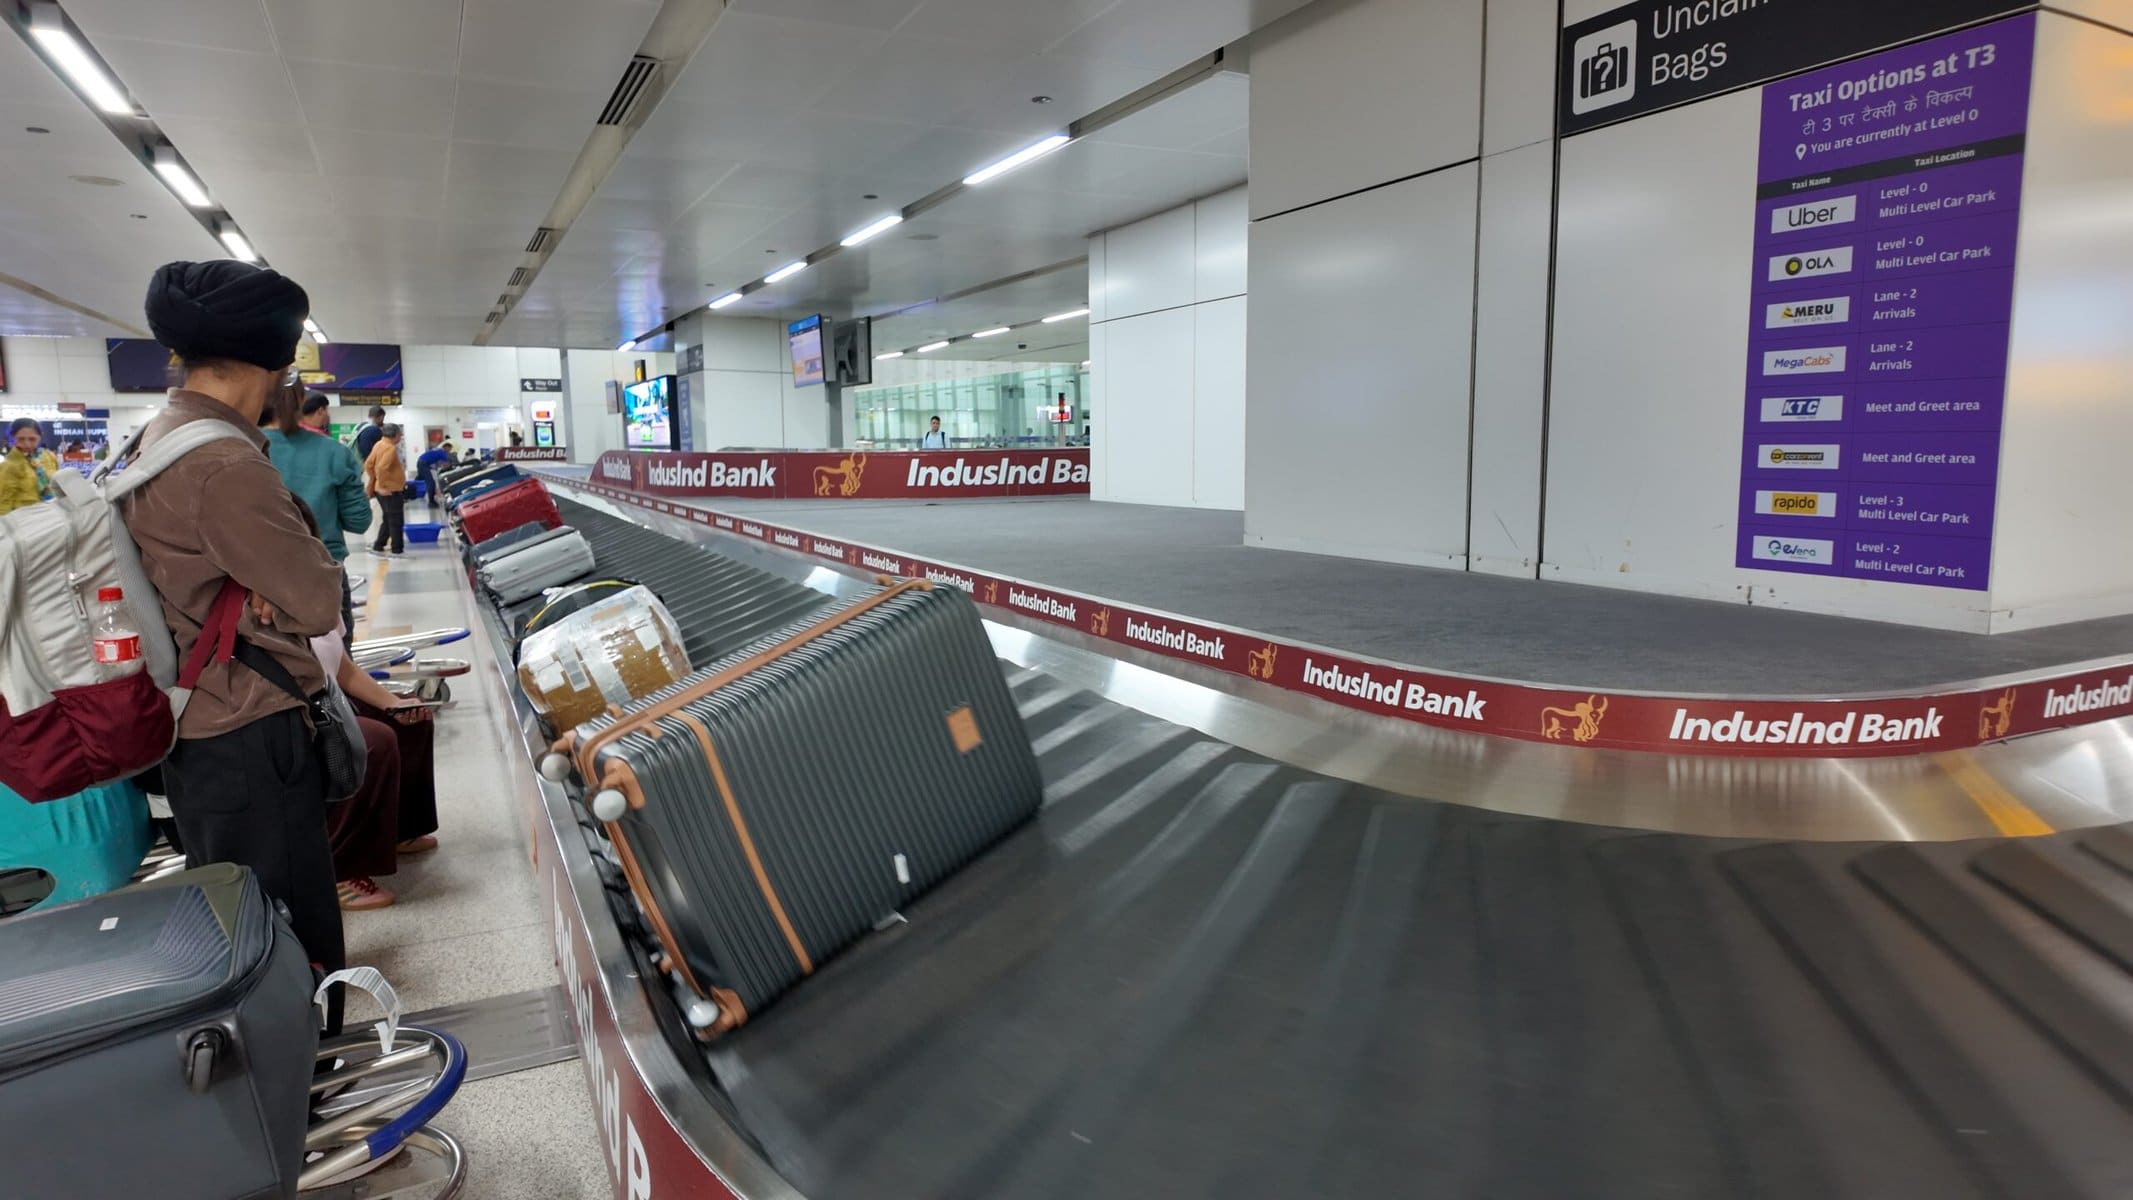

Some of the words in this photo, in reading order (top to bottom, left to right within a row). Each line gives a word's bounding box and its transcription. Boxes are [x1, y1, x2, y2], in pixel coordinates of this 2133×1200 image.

[1653, 0, 1768, 39] Uncla
[1651, 41, 1727, 85] Bags
[1789, 83, 1832, 112] Taxi
[1838, 62, 1926, 100] Options
[1931, 52, 1958, 77] at
[1965, 44, 1996, 69] T3
[1802, 118, 1815, 135] टी
[1822, 117, 1832, 132] 3
[1839, 113, 1855, 127] पर
[1862, 100, 1896, 122] टैक्सी
[1904, 95, 1918, 112] के
[1926, 86, 1974, 109] विकल्प
[1811, 140, 1831, 154] You
[1834, 137, 1853, 149] are
[1855, 123, 1911, 145] currently
[1914, 121, 1928, 133] at
[1930, 110, 1965, 129] Level
[1914, 156, 1934, 167] Taxi
[1934, 149, 1975, 164] Location
[1791, 180, 1808, 190] Taxi
[1808, 175, 1831, 187] Name
[1880, 185, 1909, 200] Level
[1879, 204, 1907, 218] Multi
[1910, 200, 1940, 214] Level
[1943, 197, 1964, 209] Car
[1966, 190, 1996, 205] Park
[1788, 205, 1837, 227] Uber
[1876, 238, 1906, 251] Level
[1805, 257, 1834, 270] OLA
[1875, 257, 1904, 270] Multi
[1906, 253, 1936, 266] Level
[1939, 250, 1960, 262] Car
[1962, 246, 1991, 259] Park
[1874, 291, 1900, 302] Lane
[1910, 289, 1917, 299] 2
[1793, 303, 1834, 317] MERU
[1873, 307, 1916, 320] Arrivals
[1870, 343, 1896, 353] Lane
[1906, 341, 1913, 351] 2
[1773, 355, 1831, 370] MegaCabs
[1869, 360, 1913, 371] Arrivals
[1783, 400, 1819, 413] KTC
[1866, 402, 1892, 413] Meet
[1894, 401, 1916, 412] and
[1919, 401, 1950, 412] Greet
[1953, 402, 1980, 411] area
[504, 448, 555, 459] IndusInd
[1862, 453, 1888, 463] Meet
[1891, 453, 1912, 463] and
[1914, 453, 1946, 464] Greet
[1949, 455, 1975, 464] area
[648, 460, 708, 487] IndusInd
[711, 459, 776, 487] Bank
[907, 457, 1049, 487] IndusInd
[1774, 495, 1815, 511] rapido
[1859, 495, 1888, 506] Level
[1896, 497, 1904, 506] 3
[1858, 509, 1886, 520] Multi
[1888, 511, 1917, 521] Level
[1919, 512, 1939, 523] Car
[1942, 513, 1969, 524] Park
[832, 544, 843, 558] Bank
[1856, 542, 1885, 553] Level
[1893, 544, 1900, 554] 2
[862, 552, 886, 571] IndusInd
[886, 556, 900, 574] Bank
[1855, 560, 1882, 570] Multi
[1884, 562, 1913, 574] Level
[1916, 564, 1935, 575] Car
[1937, 566, 1965, 578] Park
[1009, 587, 1050, 614] IndusInd
[1050, 599, 1077, 622] Bank
[1126, 617, 1184, 651] IndusInd
[1186, 632, 1225, 660] Bank
[1303, 658, 1403, 707] IndusInd
[1404, 683, 1487, 721] Bank
[2043, 675, 2133, 718] IndusInd
[1669, 708, 1856, 744] IndusInd
[1858, 708, 1944, 743] Bank
